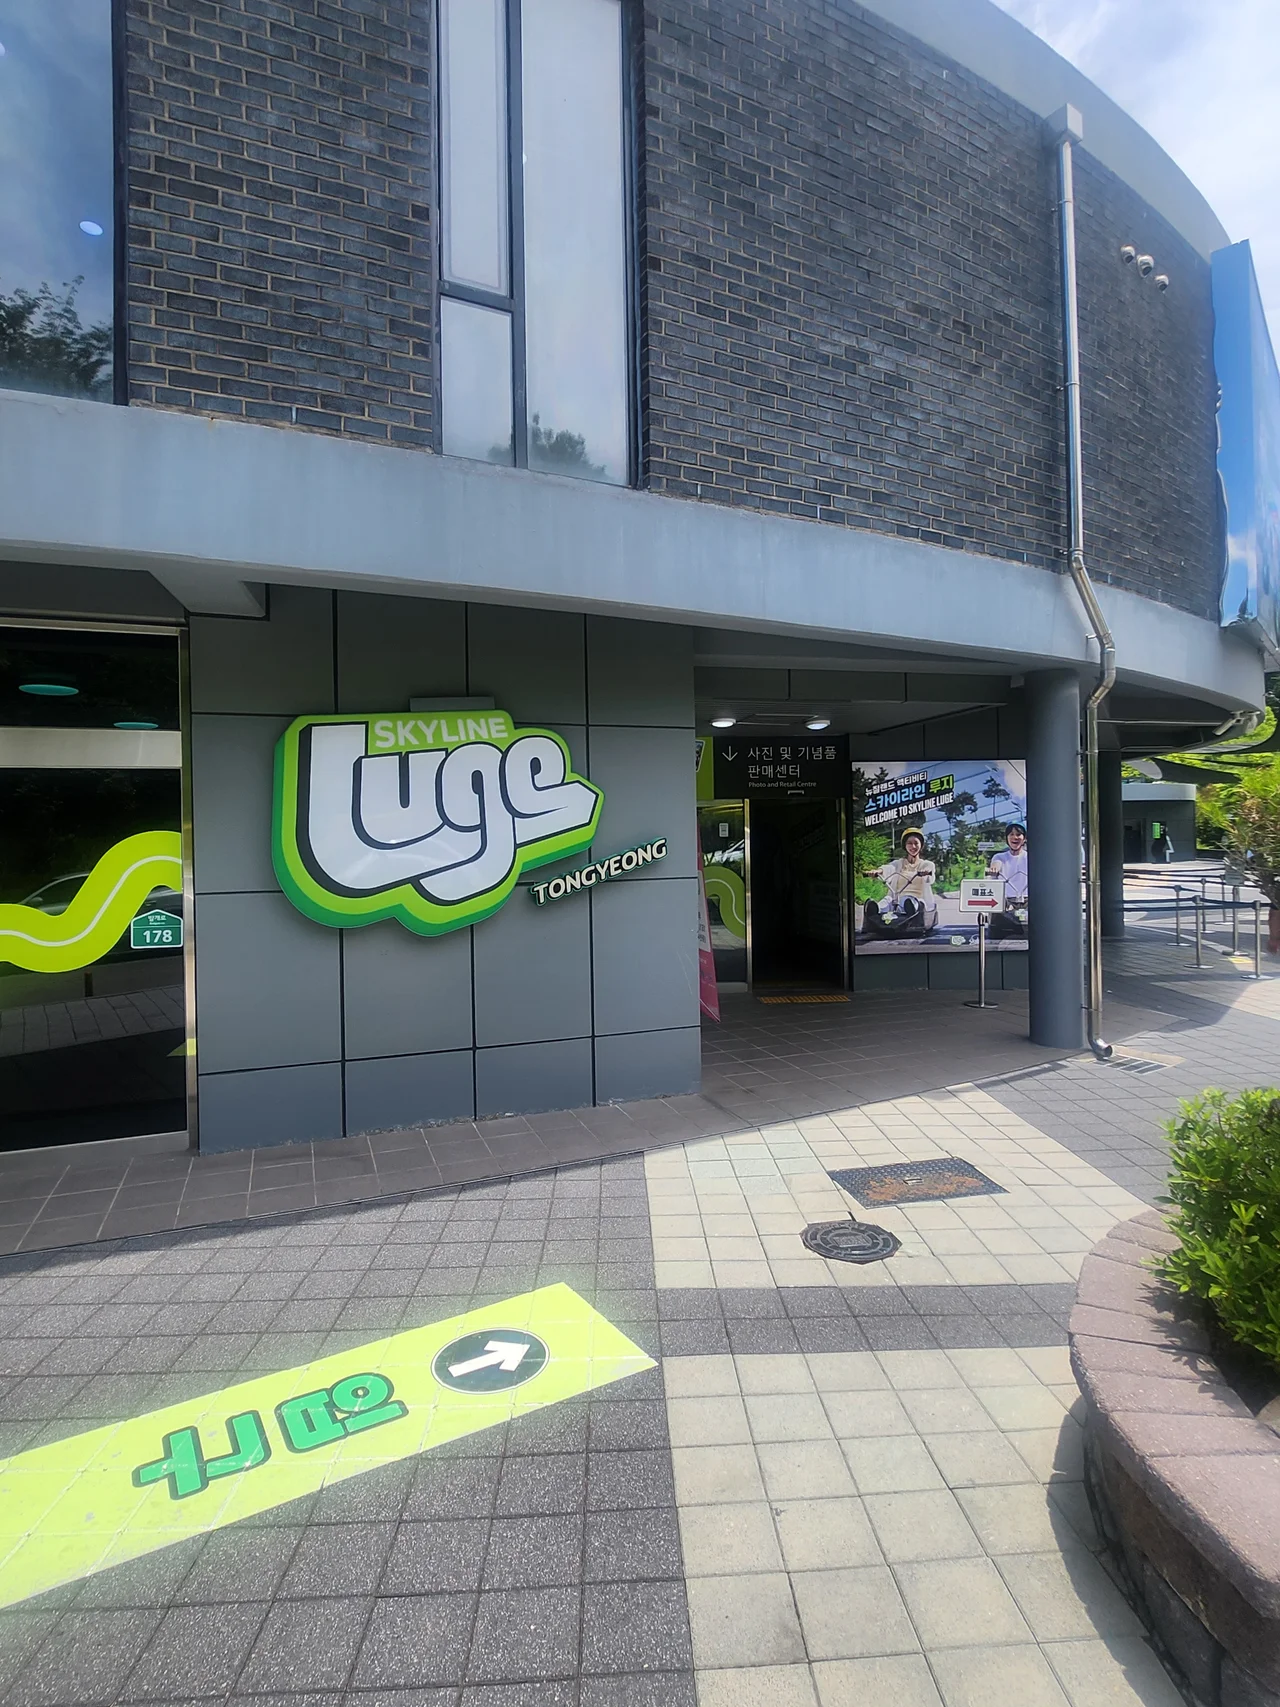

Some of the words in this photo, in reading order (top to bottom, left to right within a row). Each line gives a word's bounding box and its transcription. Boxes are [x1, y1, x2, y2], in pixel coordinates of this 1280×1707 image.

[374, 717, 509, 749] SKYLINE
[747, 746, 773, 760] 사진
[780, 746, 792, 760] 및
[798, 746, 837, 760] 기념품
[747, 764, 800, 778] 판매센터
[865, 780, 896, 796] 뉴질랜드
[896, 771, 927, 787] 액티비티
[864, 783, 926, 813] 스카이라인
[929, 775, 954, 794] 루지
[864, 810, 898, 827] WELCOME
[899, 805, 908, 817] TO
[908, 799, 936, 815] SKYLINE
[936, 792, 954, 807] LUGE
[532, 838, 668, 904] TONGYEONG
[972, 888, 995, 897] 매표소
[143, 929, 173, 943] 178
[132, 1372, 408, 1501] 입구
